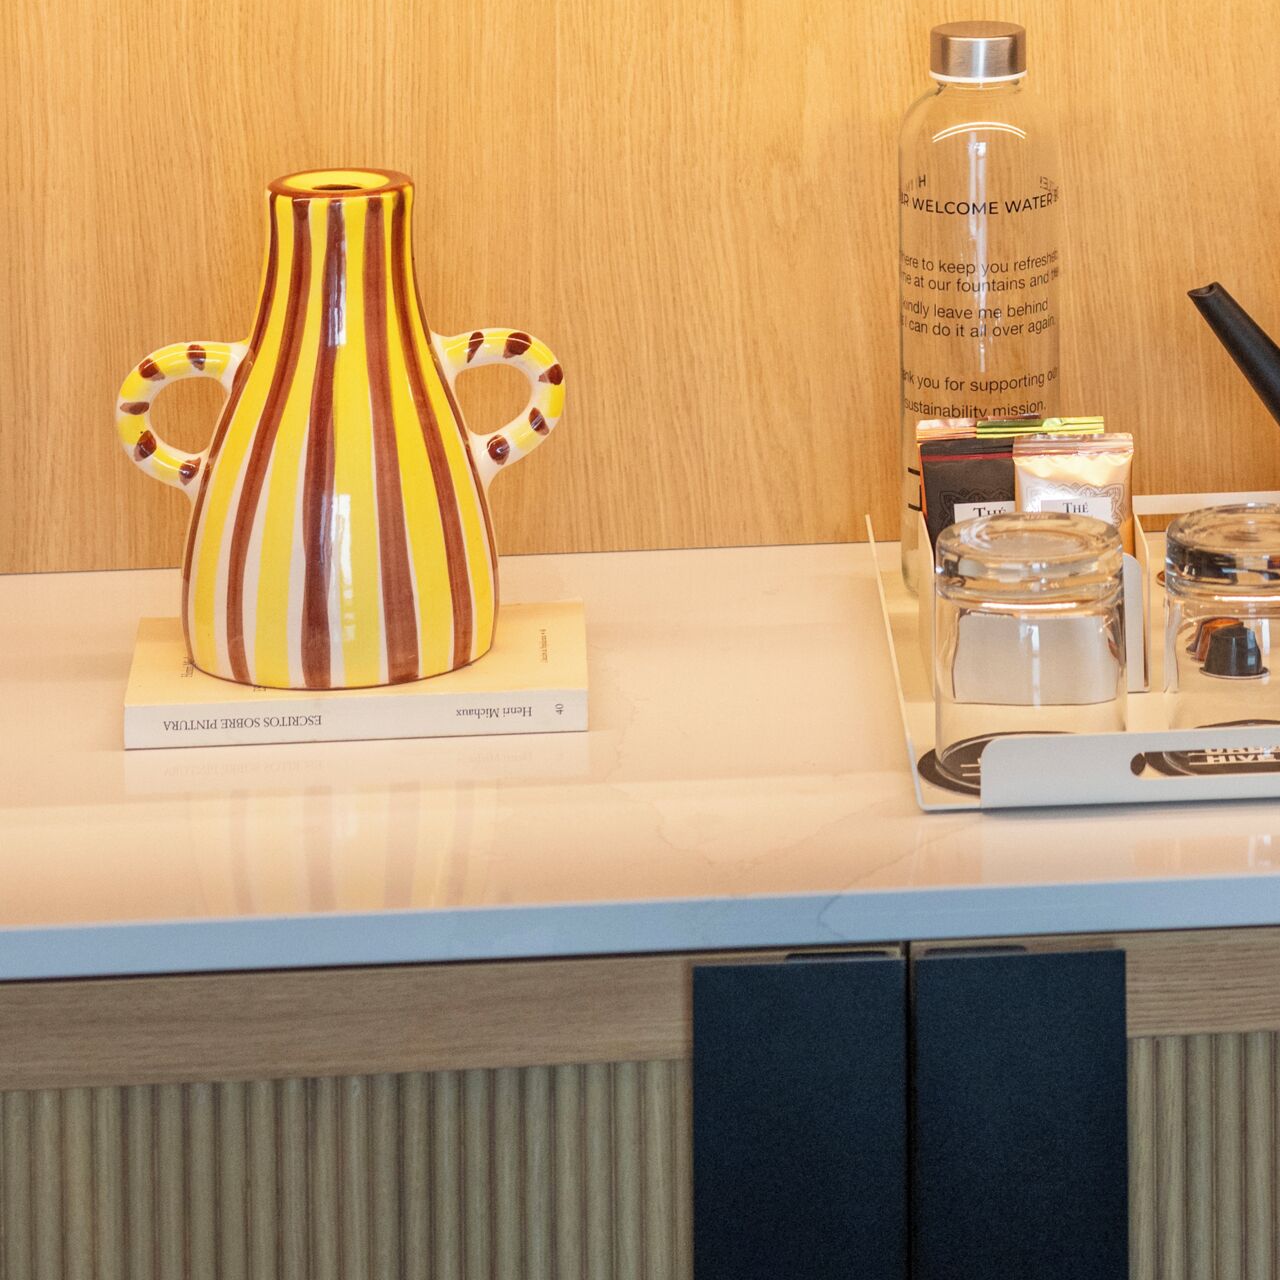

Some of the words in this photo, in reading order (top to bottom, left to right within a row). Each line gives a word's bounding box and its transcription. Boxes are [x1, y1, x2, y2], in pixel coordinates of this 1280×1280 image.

[912, 197, 999, 215] WELCOME
[1005, 192, 1054, 214] WATER
[922, 257, 934, 272] to
[938, 259, 976, 277] keep
[980, 262, 1009, 279] you
[914, 275, 925, 288] at
[928, 278, 952, 291] our
[956, 277, 1026, 293] fountains
[1029, 269, 1049, 288] and
[933, 303, 973, 320] leave
[978, 306, 1002, 319] me
[1006, 297, 1049, 317] behind
[908, 318, 928, 334] can
[932, 322, 951, 338] do
[955, 323, 965, 338] it
[969, 323, 987, 338] all
[991, 323, 1025, 337] over
[916, 374, 940, 390] you
[944, 376, 965, 392] for
[969, 372, 1045, 395] supporting
[904, 397, 988, 419] sustainability
[455, 706, 500, 718] Michaux
[502, 705, 533, 717] Henri
[554, 703, 565, 715] 40
[163, 718, 218, 733] PINTURA
[220, 717, 261, 731] SOBRE
[263, 715, 322, 730] ESCRITOS
